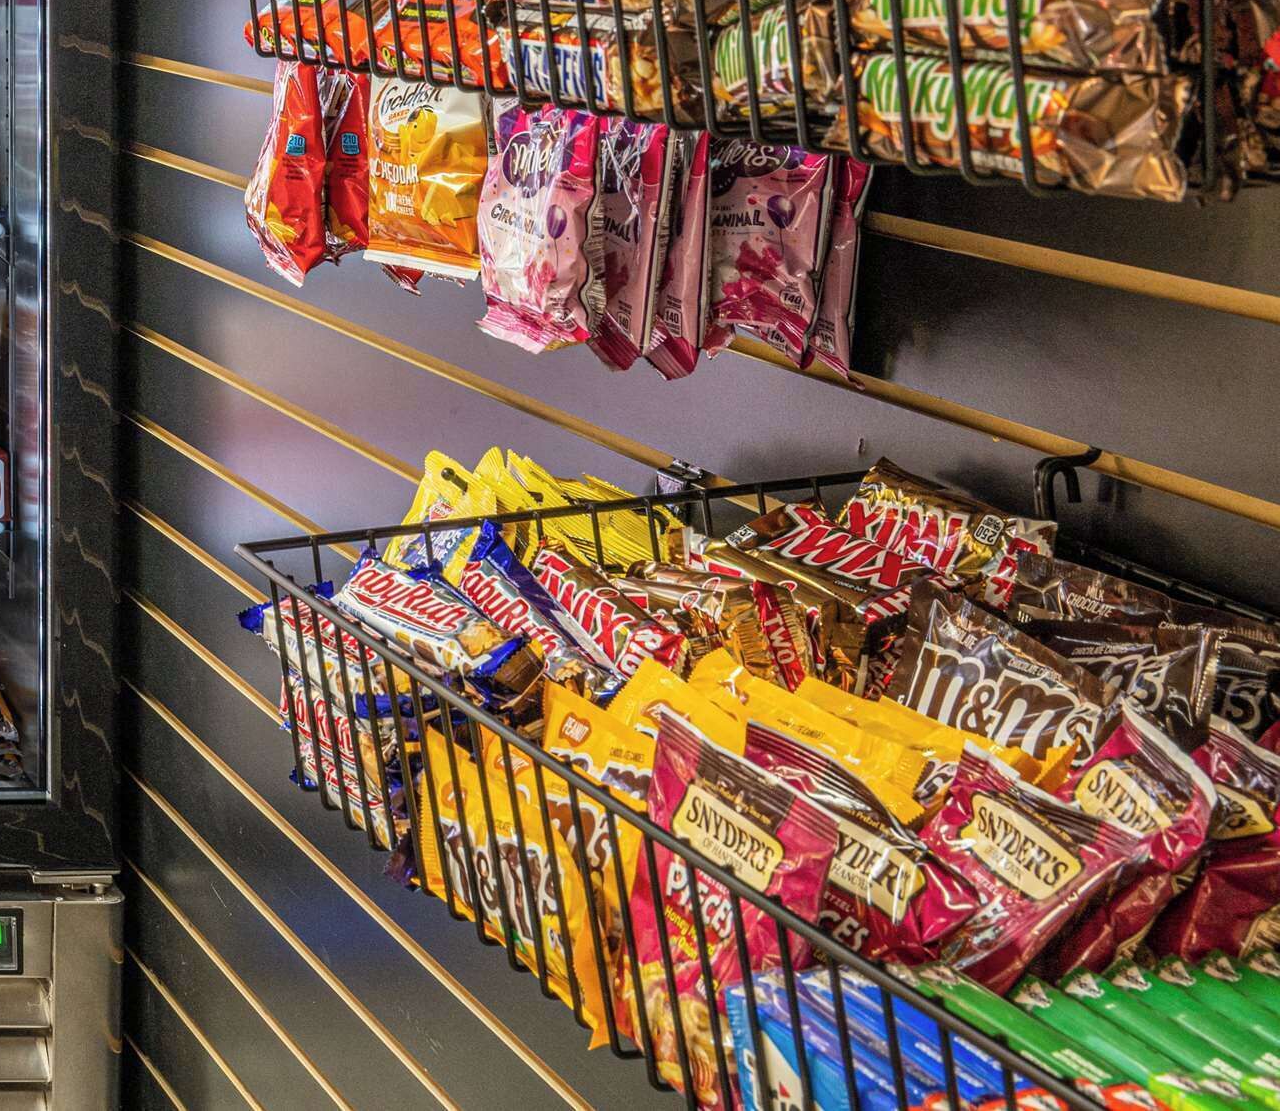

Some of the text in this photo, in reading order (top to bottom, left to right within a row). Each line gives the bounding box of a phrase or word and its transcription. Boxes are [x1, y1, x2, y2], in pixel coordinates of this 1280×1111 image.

[561, 716, 591, 742] PEANUT
[685, 796, 776, 875] SNYDER'S
[976, 805, 1070, 887] SNYDER'S
